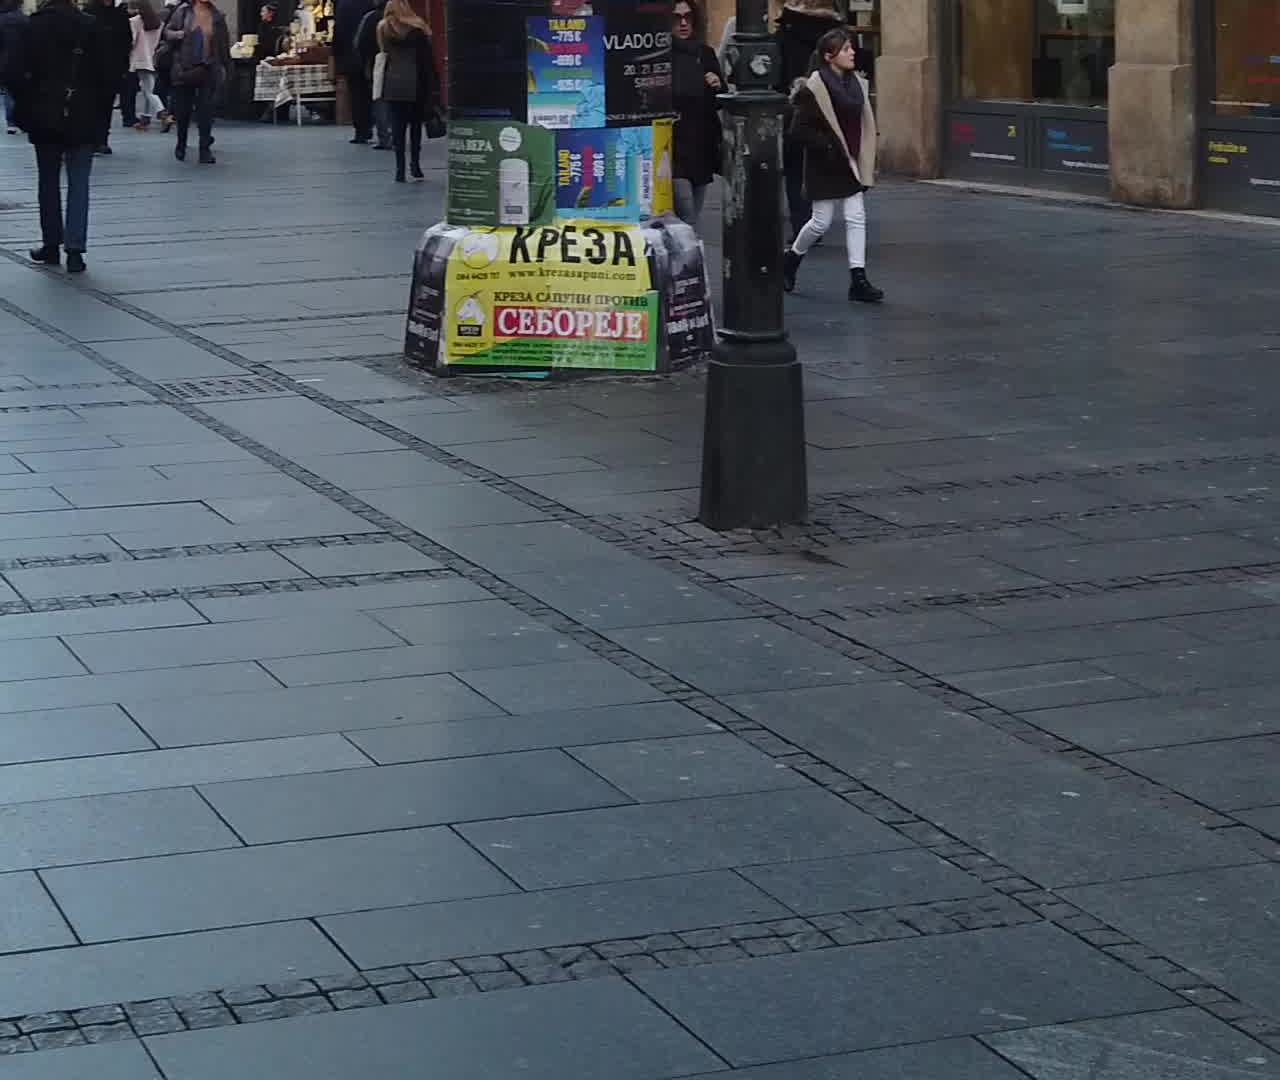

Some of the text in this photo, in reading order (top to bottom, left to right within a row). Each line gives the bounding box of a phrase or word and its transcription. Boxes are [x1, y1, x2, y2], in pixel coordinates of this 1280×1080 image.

[603, 32, 654, 50] VLADO
[509, 225, 636, 266] КРЕЗА
[494, 292, 648, 307] КРЕЗА САПУНИ ПРОТИВ
[498, 308, 642, 338] СЕБОРЕЈЕ
